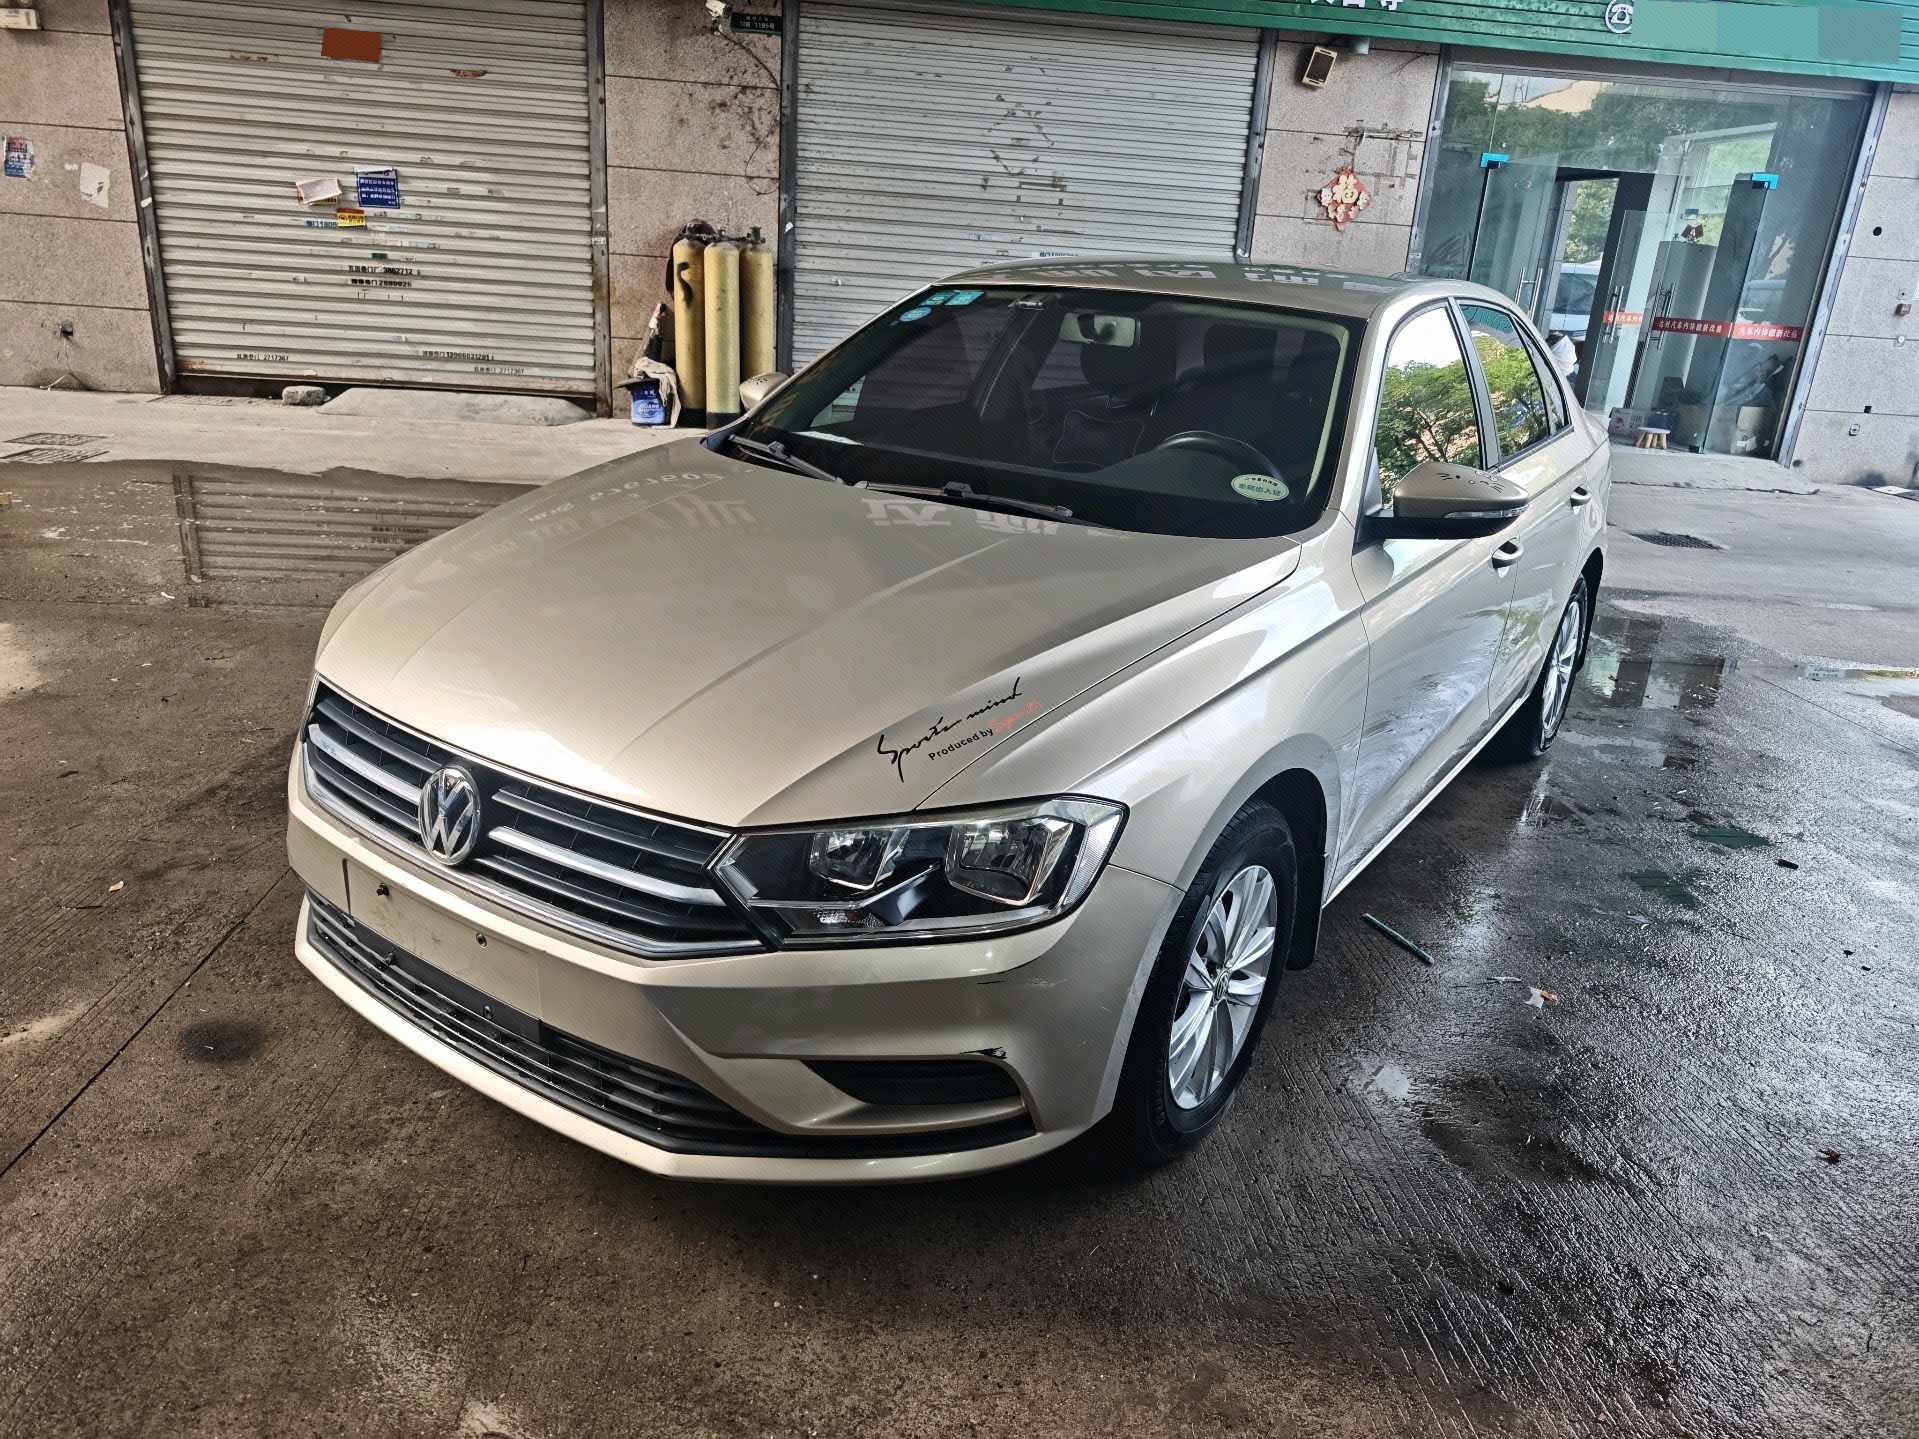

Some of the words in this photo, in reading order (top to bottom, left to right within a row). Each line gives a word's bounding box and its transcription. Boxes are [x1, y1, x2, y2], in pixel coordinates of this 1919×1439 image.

[967, 676, 1024, 721] mind
[928, 732, 980, 761] Produced
[981, 727, 994, 740] by
